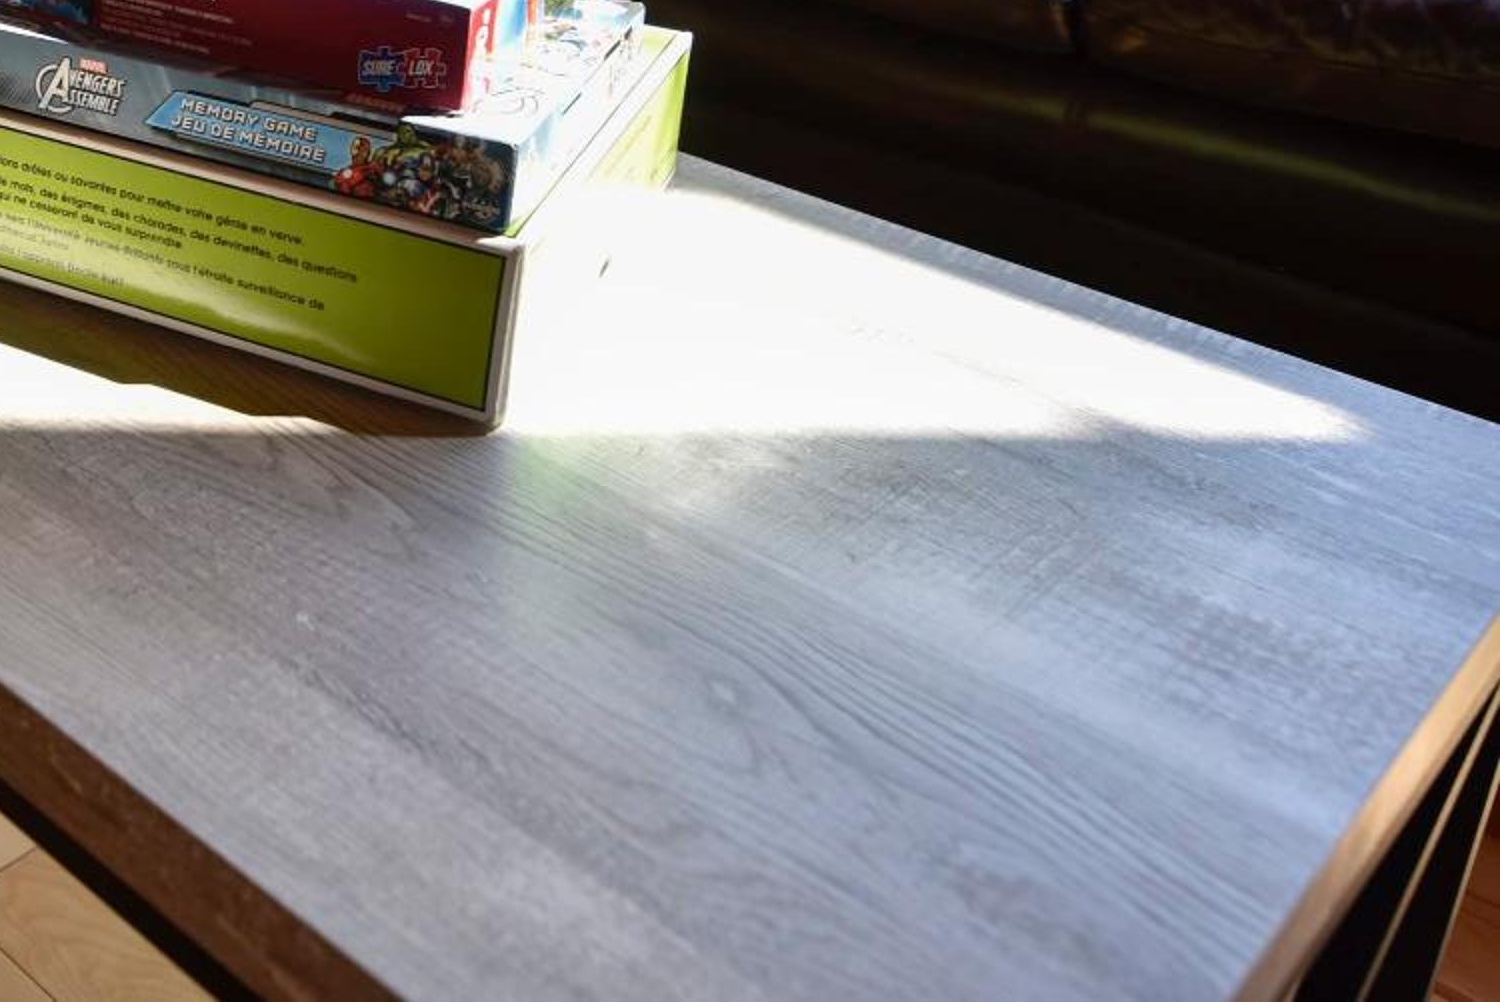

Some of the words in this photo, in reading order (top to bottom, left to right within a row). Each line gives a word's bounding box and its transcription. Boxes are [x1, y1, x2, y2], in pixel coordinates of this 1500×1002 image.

[171, 115, 205, 132] JEU
[210, 124, 234, 140] DE
[180, 98, 259, 126] MEMORY
[263, 117, 318, 141] GAME
[13, 195, 27, 206] ne
[81, 212, 95, 225] de
[97, 219, 122, 233] vous
[54, 172, 68, 182] ou
[70, 175, 117, 195] savantes
[119, 188, 145, 203] pour
[185, 207, 213, 221] votre
[251, 224, 266, 237] en
[40, 186, 59, 200] des
[111, 207, 130, 221] des
[190, 229, 210, 243] des
[277, 252, 299, 268] des
[301, 260, 357, 283] questions
